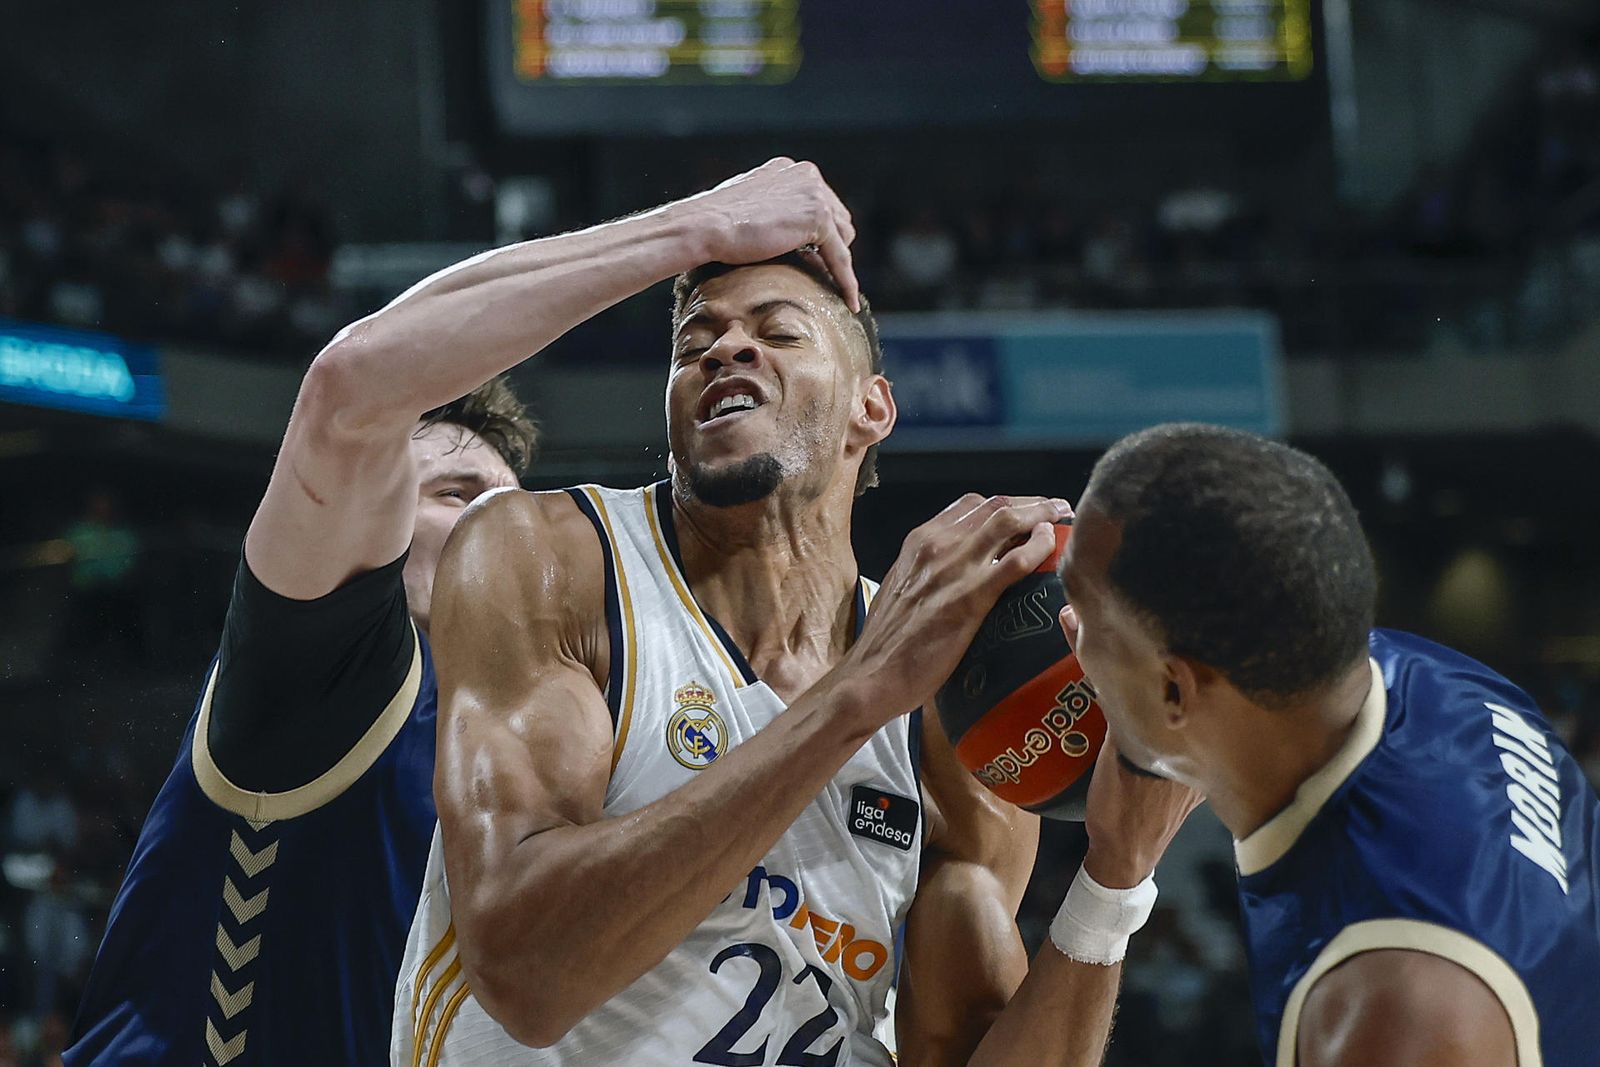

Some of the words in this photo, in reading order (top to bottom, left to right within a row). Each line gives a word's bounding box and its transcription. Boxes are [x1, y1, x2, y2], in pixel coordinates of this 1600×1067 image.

[856, 800, 885, 820] liga
[855, 818, 911, 845] endesa
[692, 942, 846, 1066] 22
